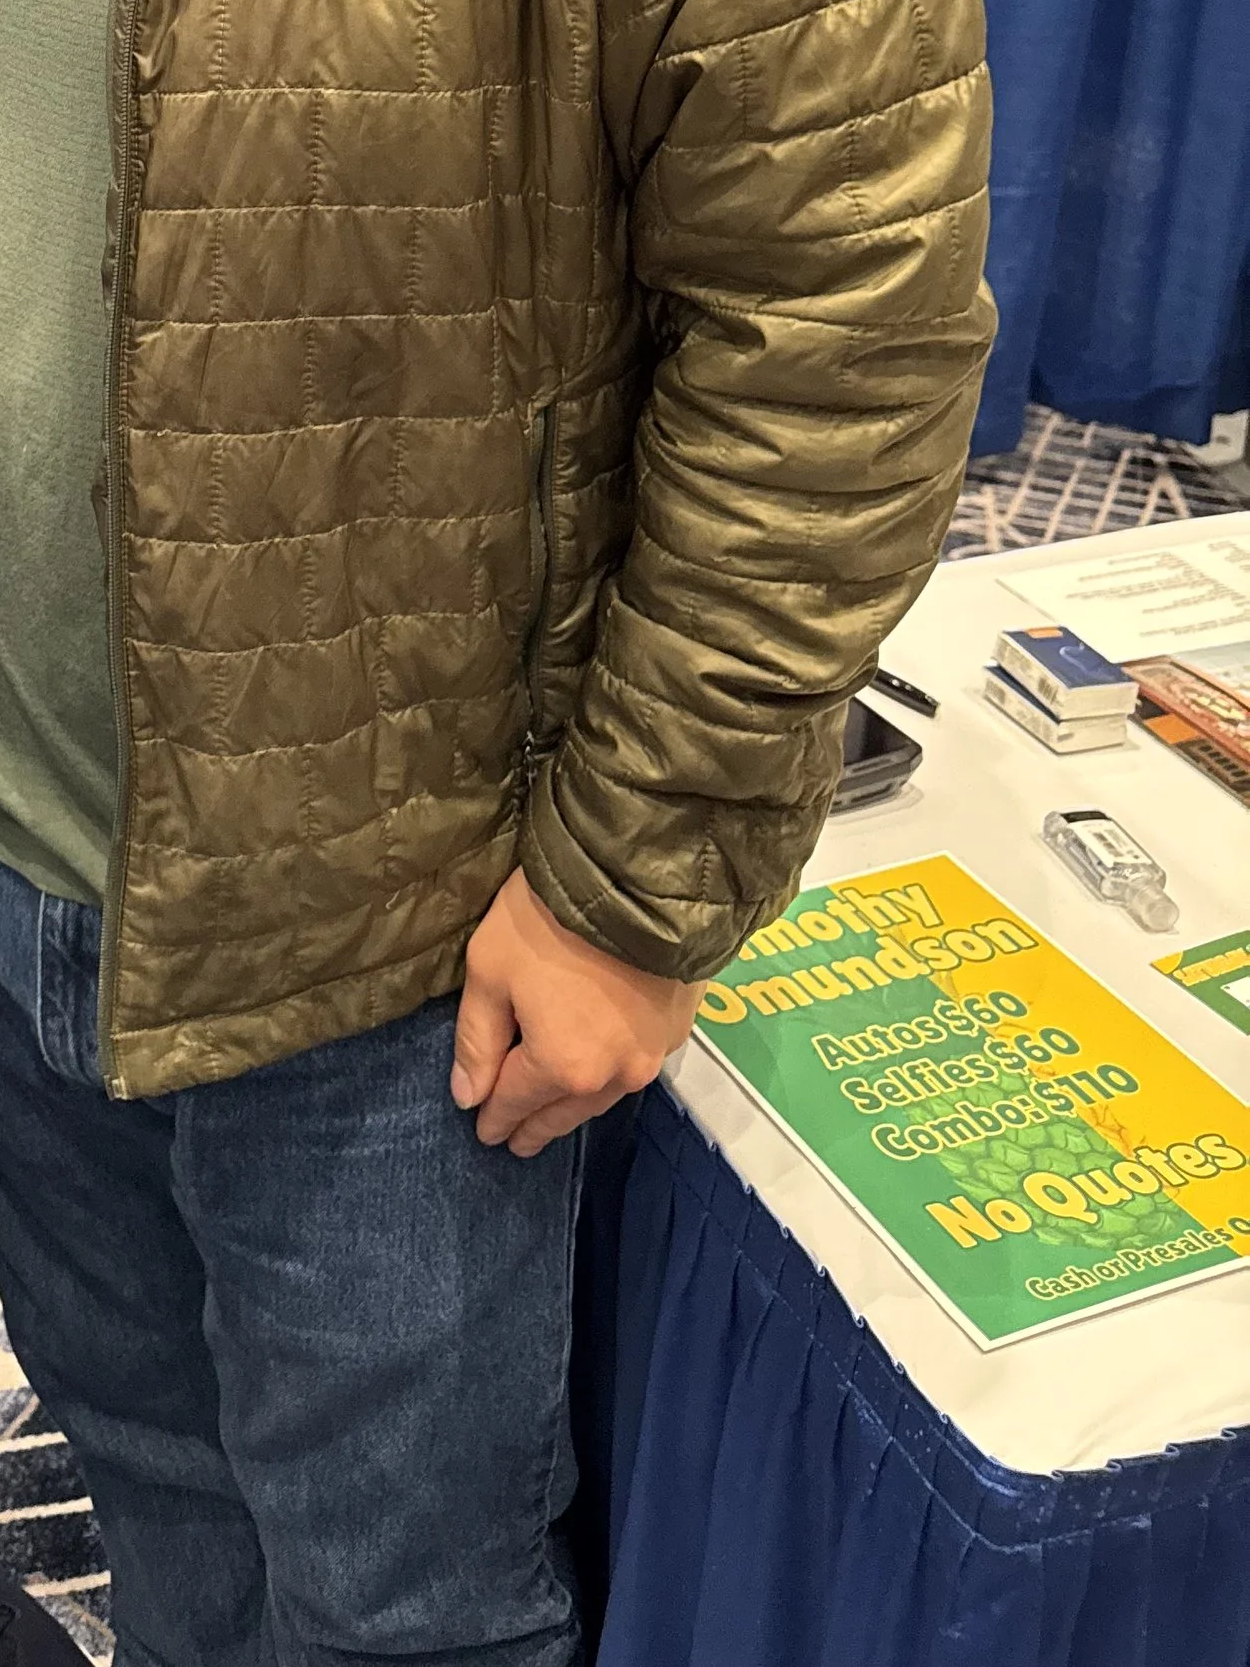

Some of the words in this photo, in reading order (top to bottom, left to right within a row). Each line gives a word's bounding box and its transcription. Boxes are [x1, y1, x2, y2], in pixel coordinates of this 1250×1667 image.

[735, 883, 945, 961] mothy
[700, 918, 1038, 1024] Omundson
[812, 1016, 948, 1070] Autos
[934, 990, 1028, 1036] $60
[841, 1054, 999, 1114] Selfies
[984, 1026, 1080, 1074] $60
[872, 1096, 1048, 1161] Combo:
[1030, 1064, 1140, 1117] $110
[924, 1196, 1033, 1249] No
[1022, 1133, 1247, 1225] Quotes
[1027, 1266, 1099, 1300] Cash
[1092, 1256, 1132, 1282] or
[1120, 1226, 1235, 1271] Presales
